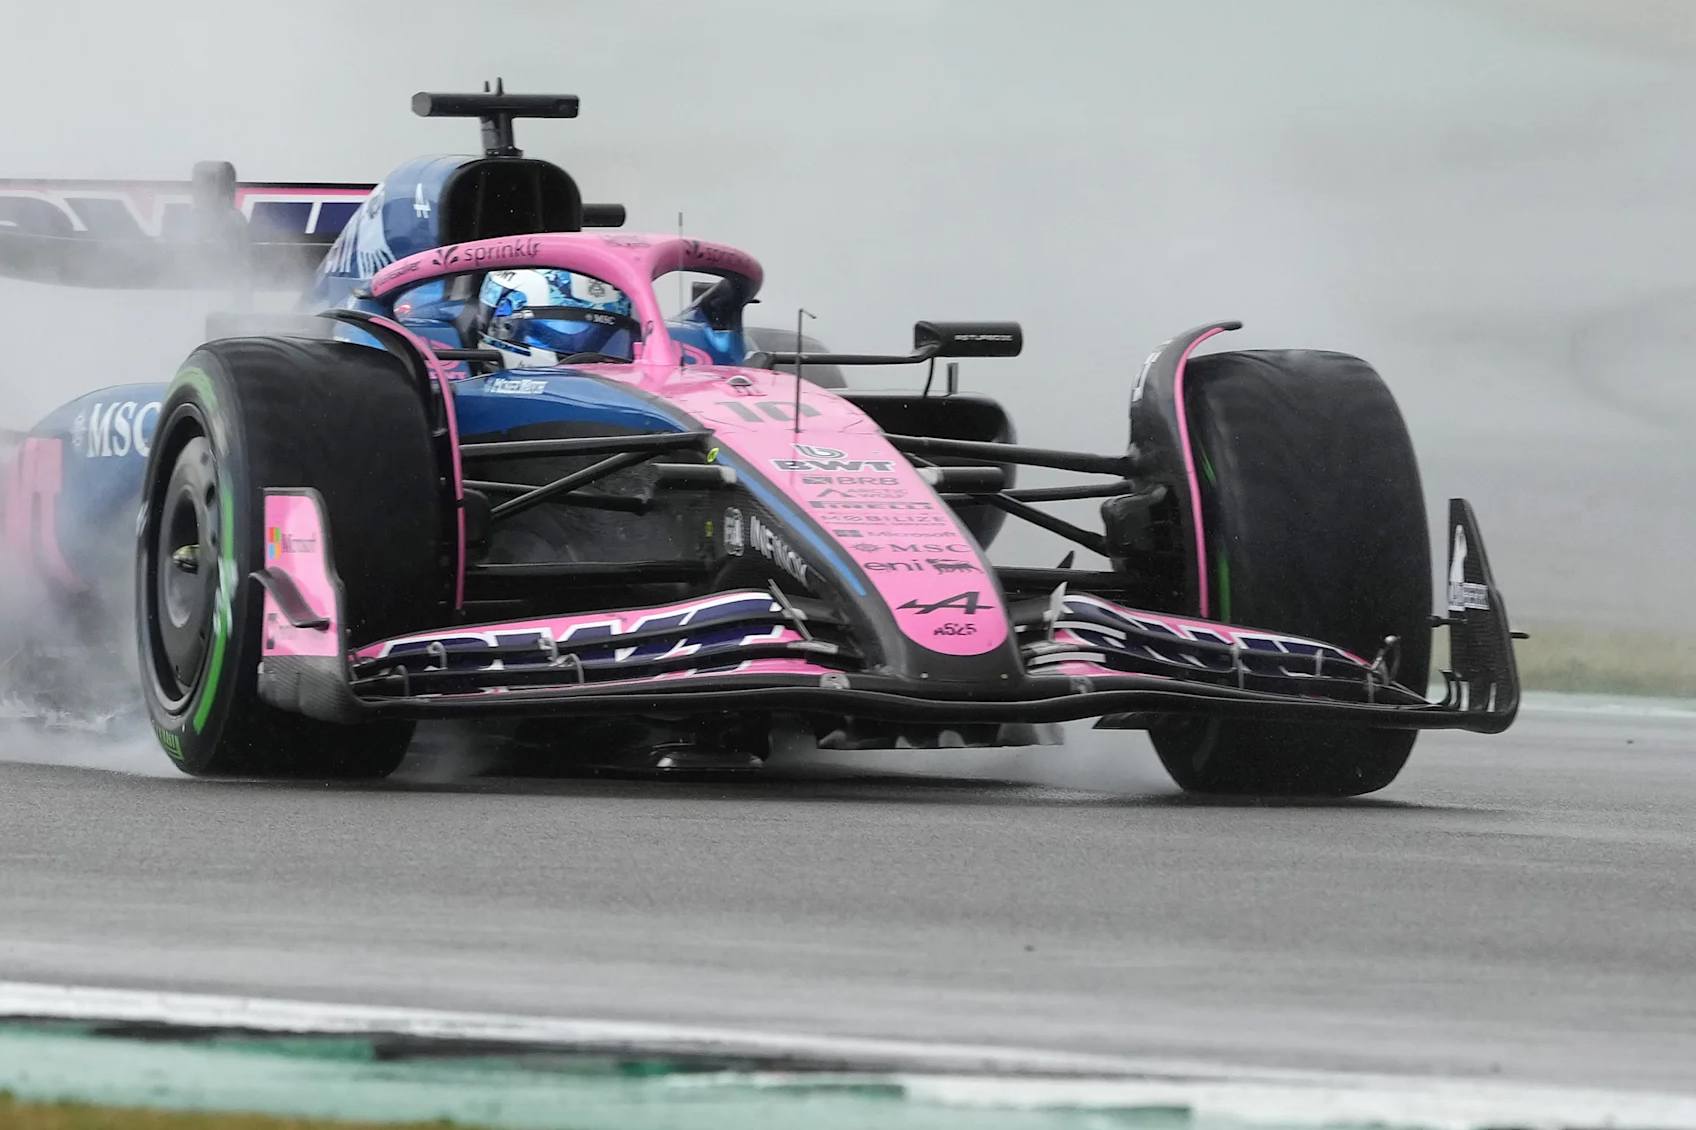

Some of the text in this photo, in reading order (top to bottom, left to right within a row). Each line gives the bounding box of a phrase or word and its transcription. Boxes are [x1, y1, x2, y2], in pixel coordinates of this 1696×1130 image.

[464, 238, 540, 266] sprinklr
[715, 402, 822, 422] 10
[86, 401, 162, 458] MSC
[771, 459, 895, 471] BWT
[836, 476, 900, 485] BRB
[886, 543, 973, 553] MSC
[864, 559, 925, 572] eni
